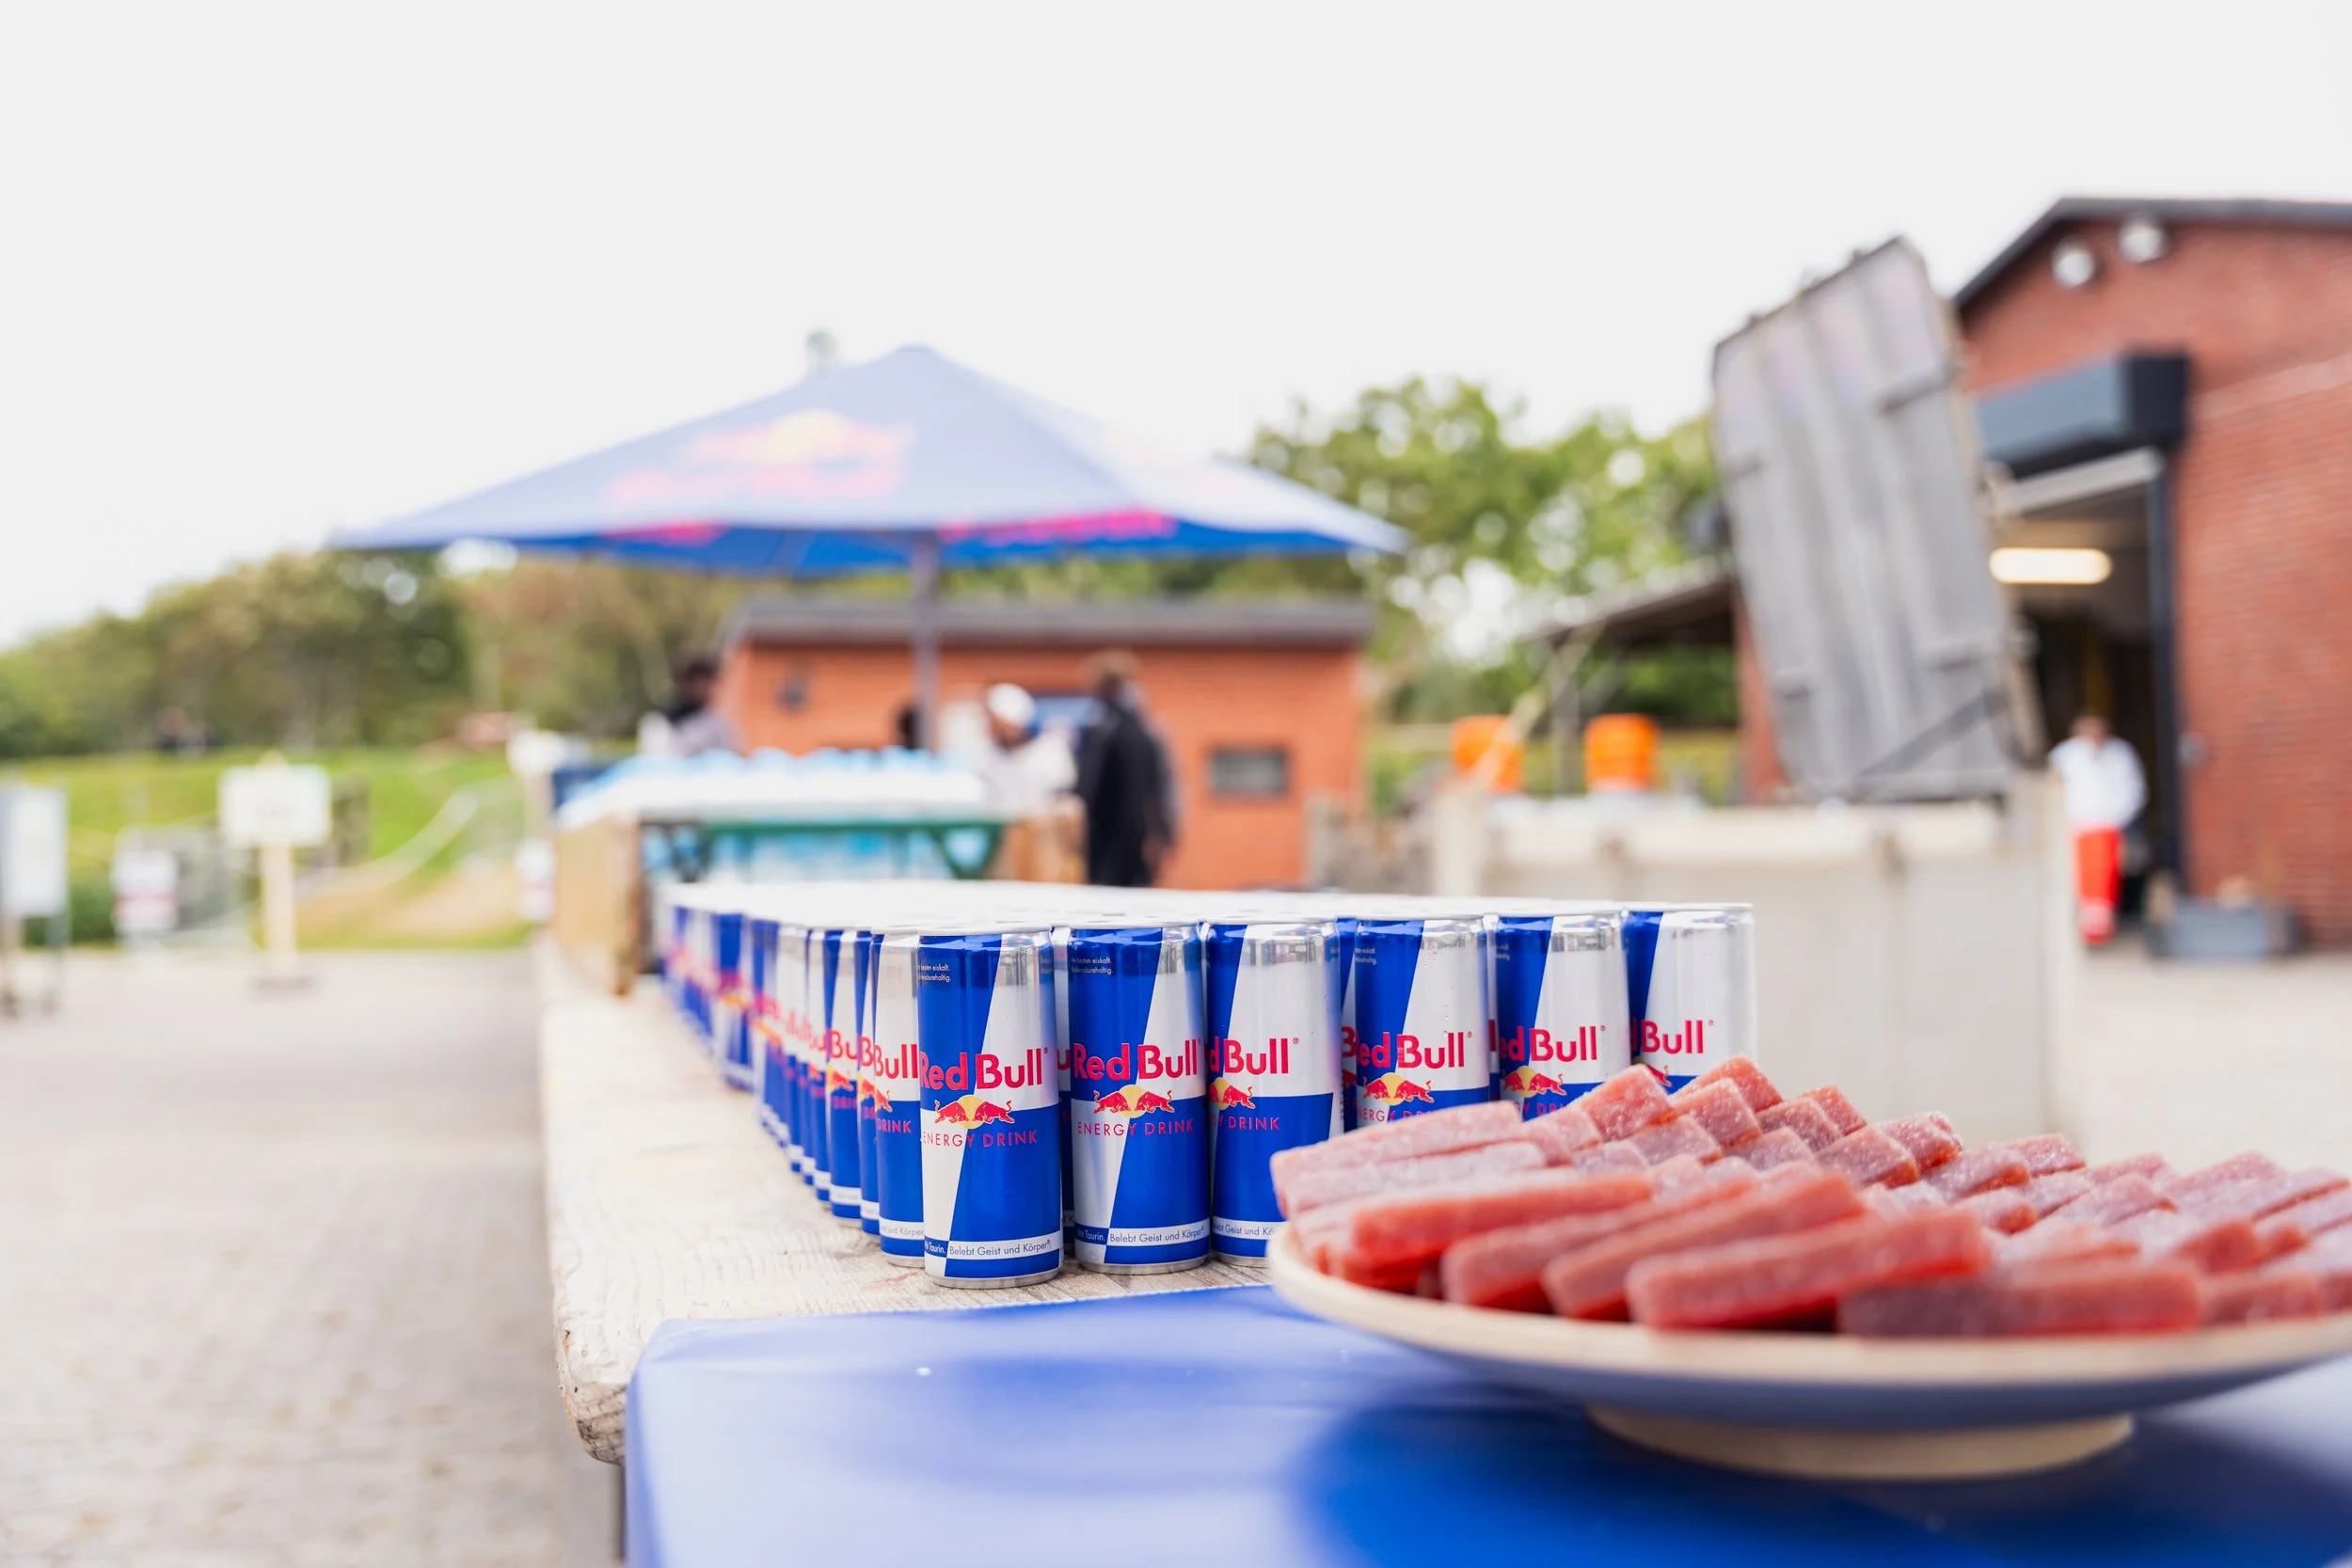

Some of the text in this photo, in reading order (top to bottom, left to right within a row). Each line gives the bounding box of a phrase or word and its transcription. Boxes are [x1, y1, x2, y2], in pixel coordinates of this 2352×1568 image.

[1500, 1026, 1525, 1062] ed
[875, 1044, 919, 1079] Bull
[919, 1051, 968, 1090] Red
[1073, 1043, 1131, 1081] Red
[1229, 1117, 1280, 1131] DRINK
[1358, 1110, 1396, 1123] NERGY
[1077, 1121, 1137, 1136] ENERGY
[1144, 1118, 1194, 1136] DRINK
[923, 1130, 1037, 1148] ENERGY DRINK
[1110, 1233, 1136, 1242] Belebt
[1139, 1233, 1162, 1242] Geist
[1165, 1230, 1180, 1241] und
[1225, 1224, 1242, 1234] Geist
[1245, 1227, 1260, 1235] und
[929, 1242, 946, 1254] Taurin.
[949, 1245, 975, 1256] Belebt
[977, 1246, 1001, 1256] Geist
[1004, 1244, 1020, 1255] und
